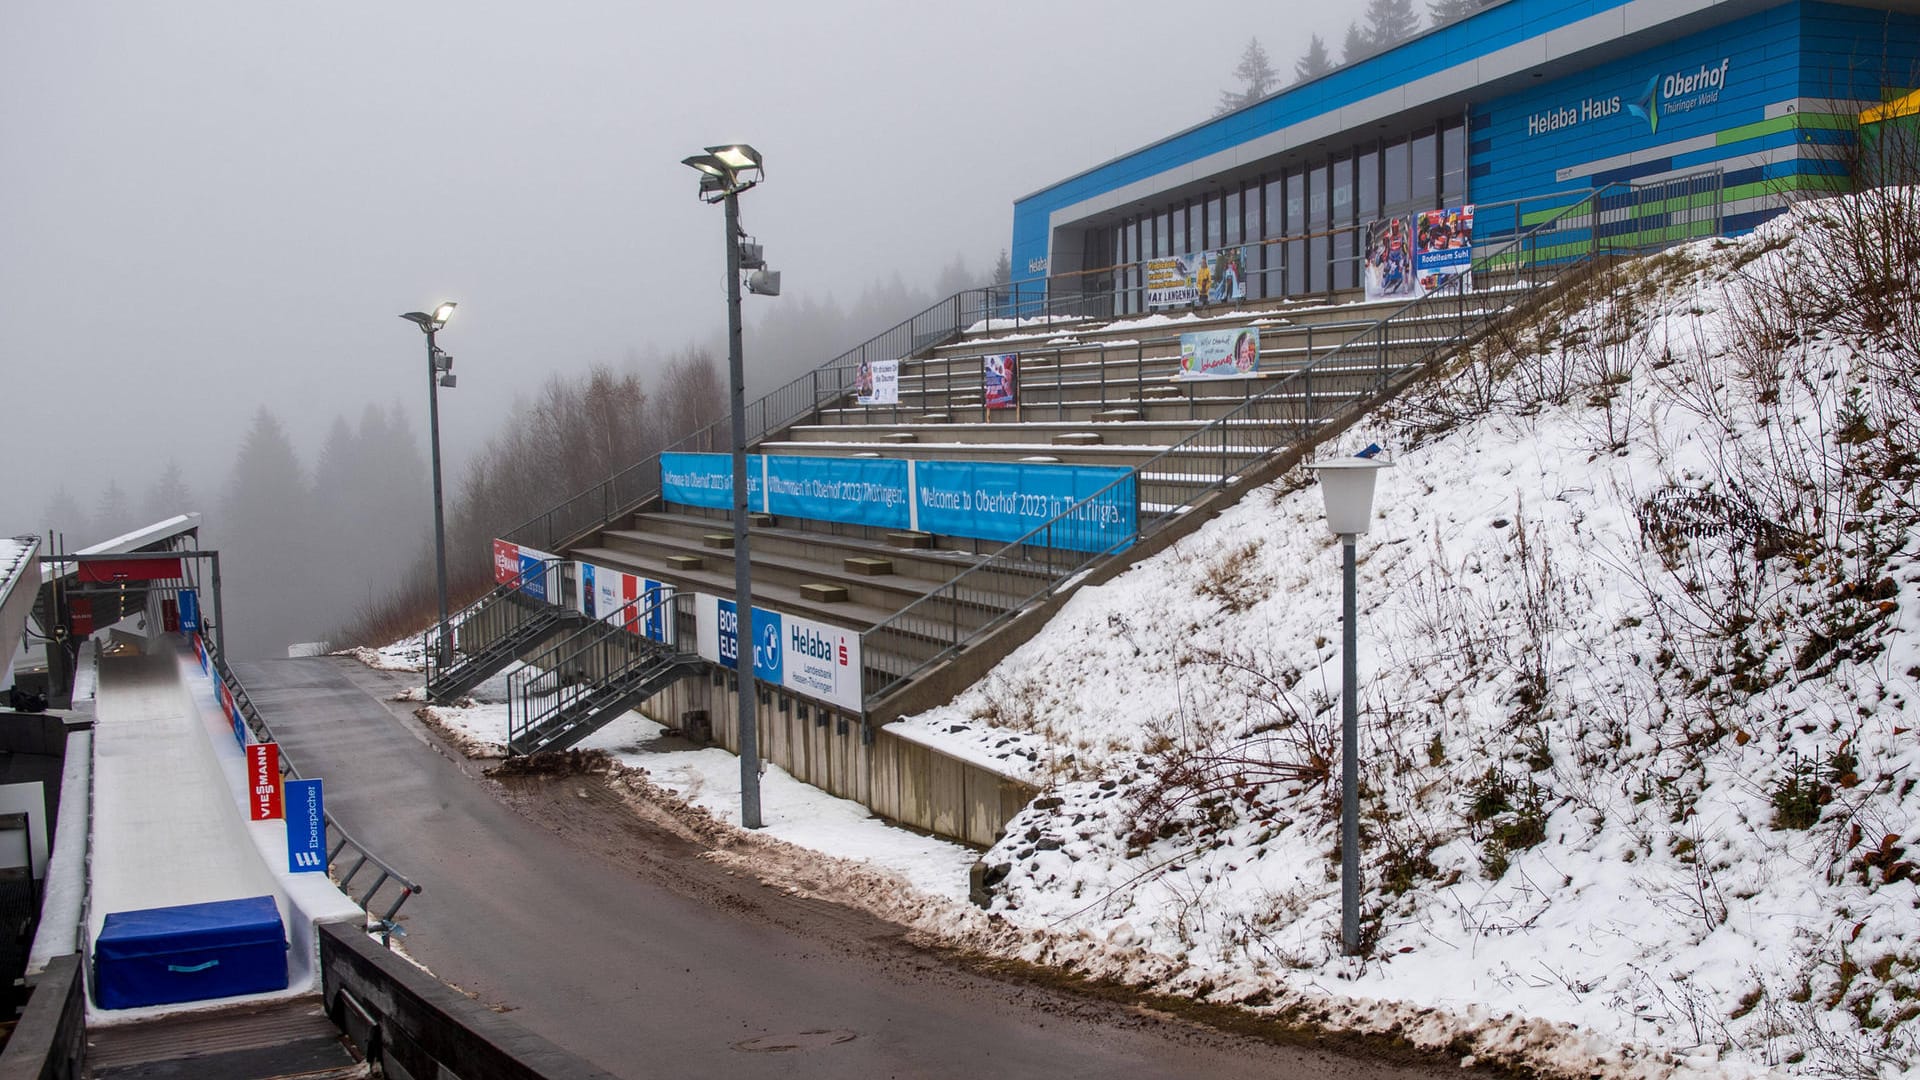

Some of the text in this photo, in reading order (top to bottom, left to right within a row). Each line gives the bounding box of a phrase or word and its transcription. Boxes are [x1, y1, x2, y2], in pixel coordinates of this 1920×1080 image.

[1663, 58, 1729, 99] Oberhof
[1528, 96, 1621, 136] Helaba Haus
[1663, 92, 1719, 115] Thüringer Wald
[1422, 252, 1453, 263] Rodelteam
[1454, 249, 1469, 259] Suhl
[813, 479, 841, 499] Oberhof
[920, 486, 961, 510] Welcome
[963, 490, 972, 511] to
[975, 489, 1018, 515] Oberhof
[1019, 494, 1047, 518] 2023
[1050, 494, 1061, 517] in
[791, 624, 832, 662] Helaba
[803, 663, 832, 680] Landesbank
[256, 746, 274, 818] VIESSMANN
